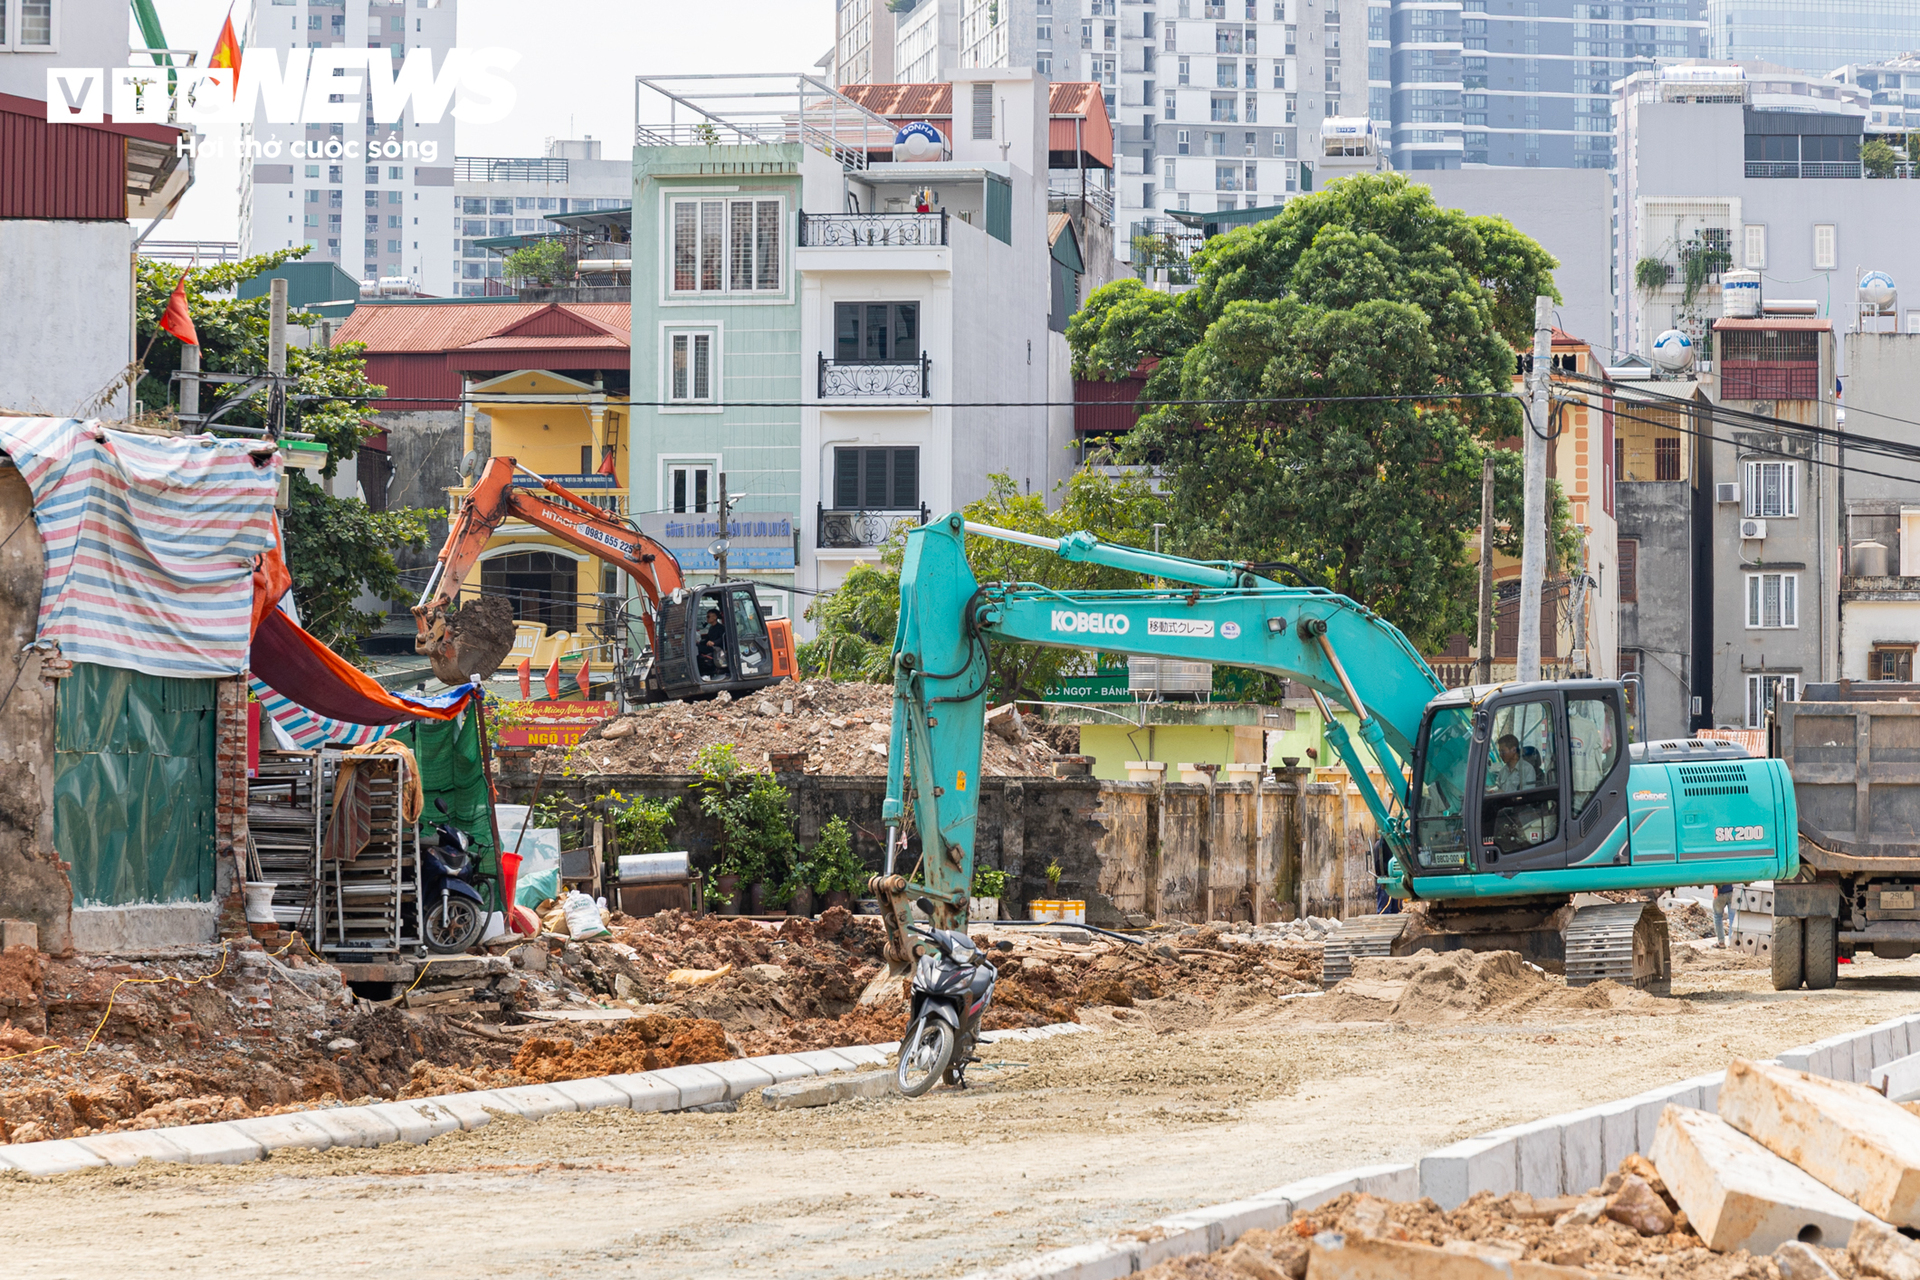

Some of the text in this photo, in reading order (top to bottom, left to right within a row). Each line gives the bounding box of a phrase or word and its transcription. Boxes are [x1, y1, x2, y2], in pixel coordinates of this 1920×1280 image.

[686, 522, 695, 537] TY
[585, 526, 603, 541] 0983
[604, 535, 619, 548] 655
[619, 541, 634, 554] 225
[1051, 610, 1130, 635] KOBELCO
[1149, 620, 1214, 635] 移動式クレーン
[1063, 686, 1092, 698] NGỌT
[1101, 685, 1130, 696] BÁNH
[528, 731, 583, 744] NGÕ 13
[1715, 825, 1764, 842] SK200
